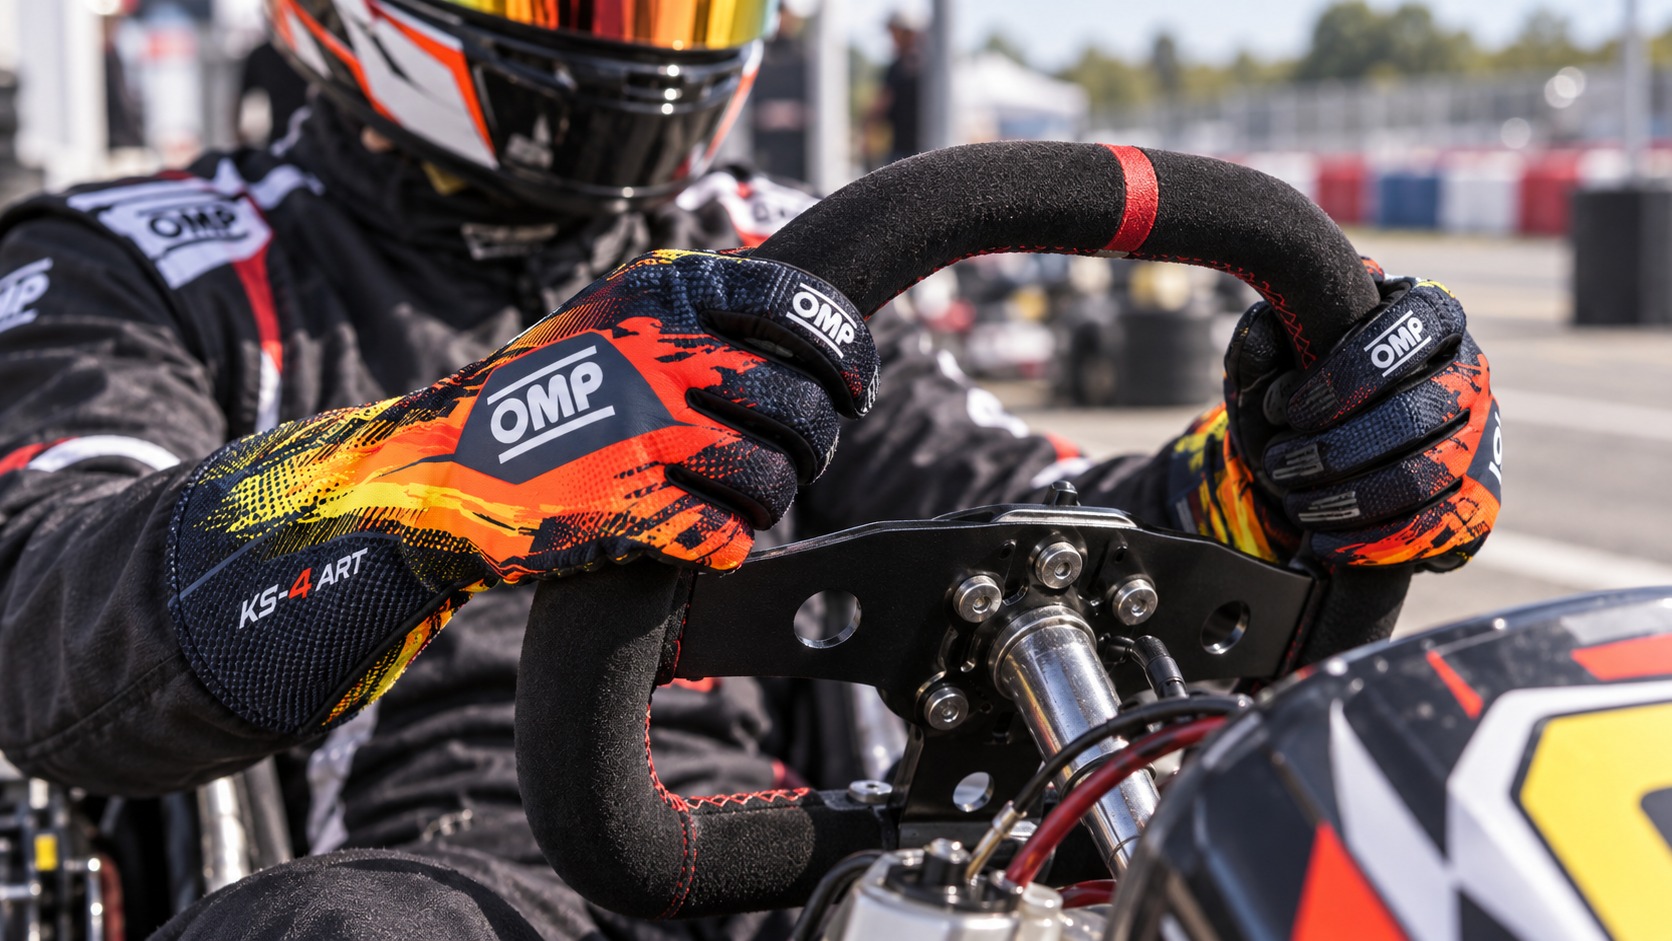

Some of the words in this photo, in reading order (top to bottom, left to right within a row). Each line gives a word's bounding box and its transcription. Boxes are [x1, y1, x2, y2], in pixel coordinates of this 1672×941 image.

[149, 207, 237, 239] OMP
[792, 291, 855, 345] OMP
[1371, 317, 1423, 368] OMP
[490, 361, 604, 444] OMP
[239, 567, 313, 630] KS-4
[315, 547, 369, 592] ART
